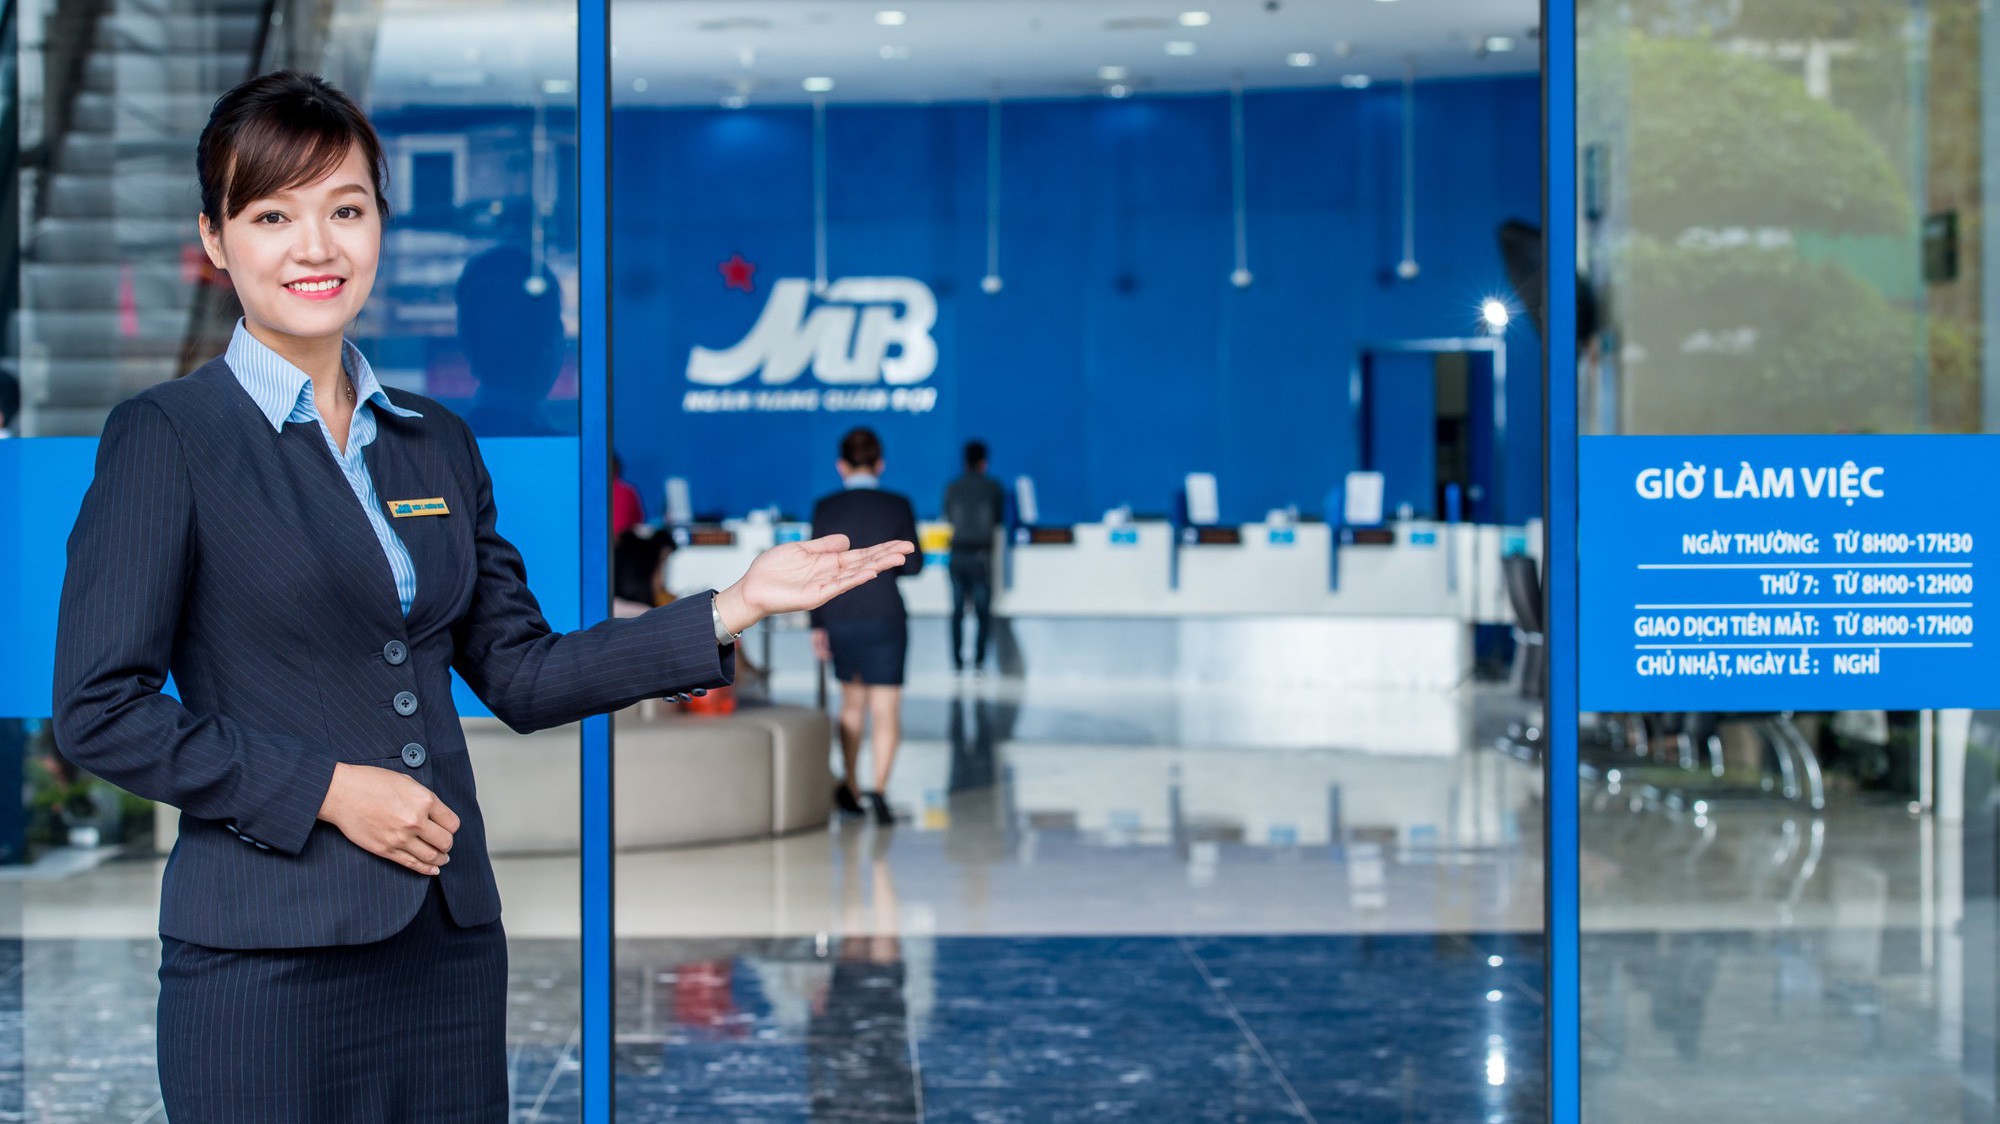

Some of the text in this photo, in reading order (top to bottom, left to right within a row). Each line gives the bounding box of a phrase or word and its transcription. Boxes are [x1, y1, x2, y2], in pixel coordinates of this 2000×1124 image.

[1635, 460, 1885, 507] GIỜ LÀM VIỆC
[1683, 529, 1732, 555] NGÀY
[1861, 533, 1974, 554] 8H00-17H30
[1802, 574, 1820, 595] 7:
[1861, 574, 1974, 595] 8H00-12H00
[1634, 616, 1681, 637] GIAO
[1683, 615, 1728, 642] DỊCH
[1862, 615, 1974, 636] 8H00-17H00
[1636, 649, 1676, 676] CHỦ
[1678, 651, 1733, 681] NHẬT,
[1736, 650, 1787, 676] NGÀY
[1833, 648, 1880, 675] NGHỈ
